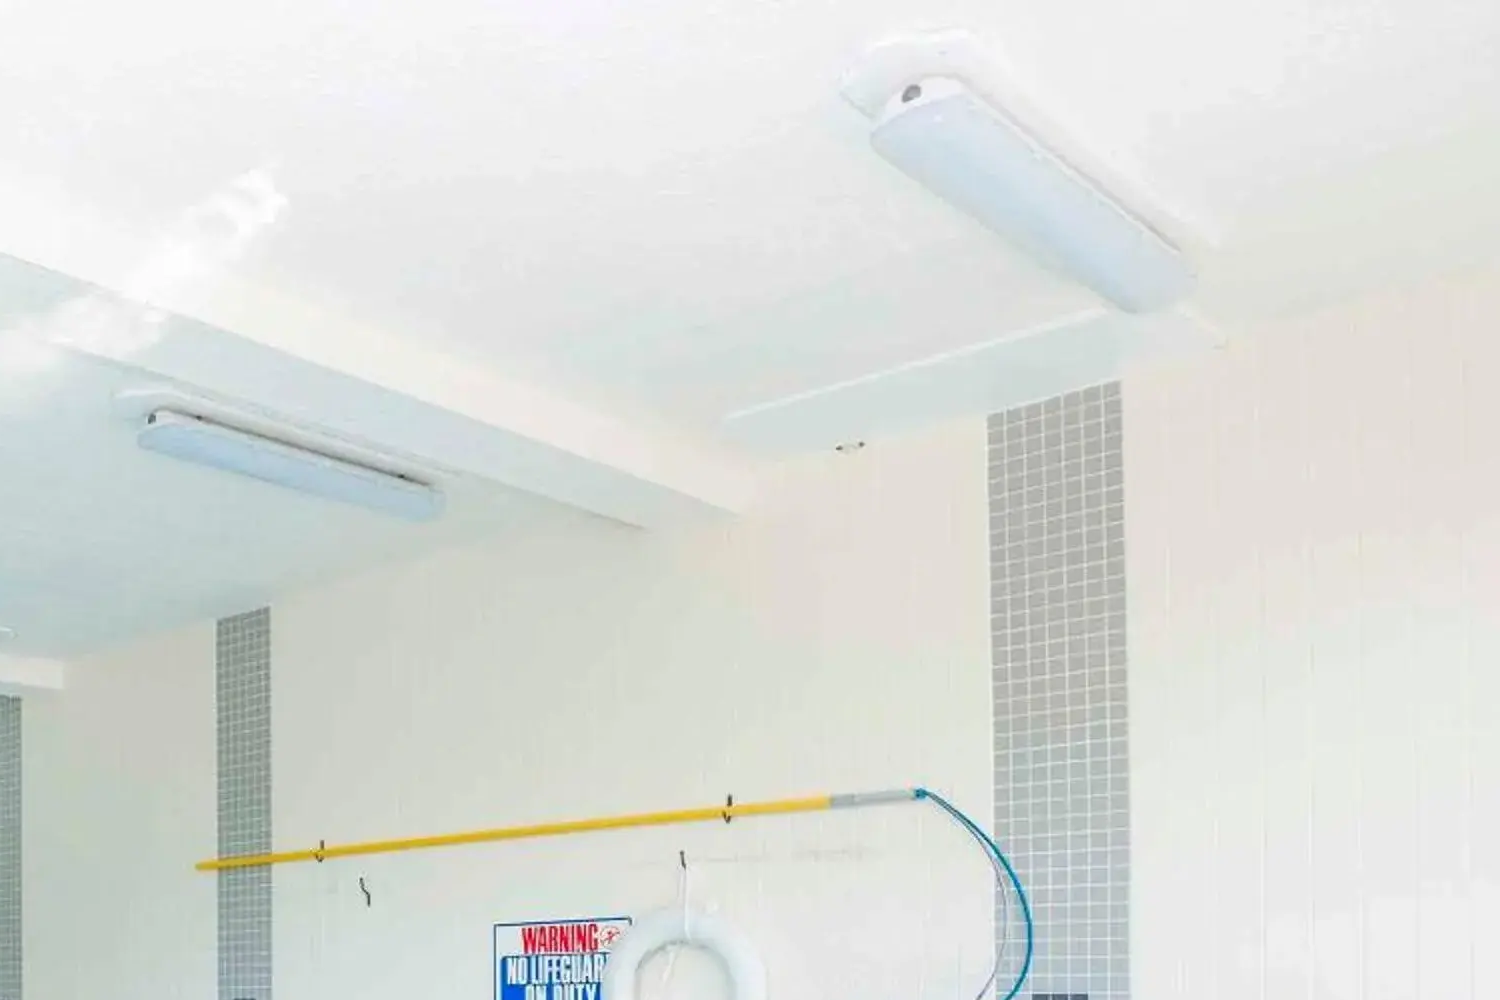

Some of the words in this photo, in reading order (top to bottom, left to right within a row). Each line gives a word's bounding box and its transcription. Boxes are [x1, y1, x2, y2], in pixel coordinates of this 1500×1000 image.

[520, 923, 599, 954] WARNING
[507, 956, 528, 984] NO
[531, 953, 608, 983] LIFEGUAR
